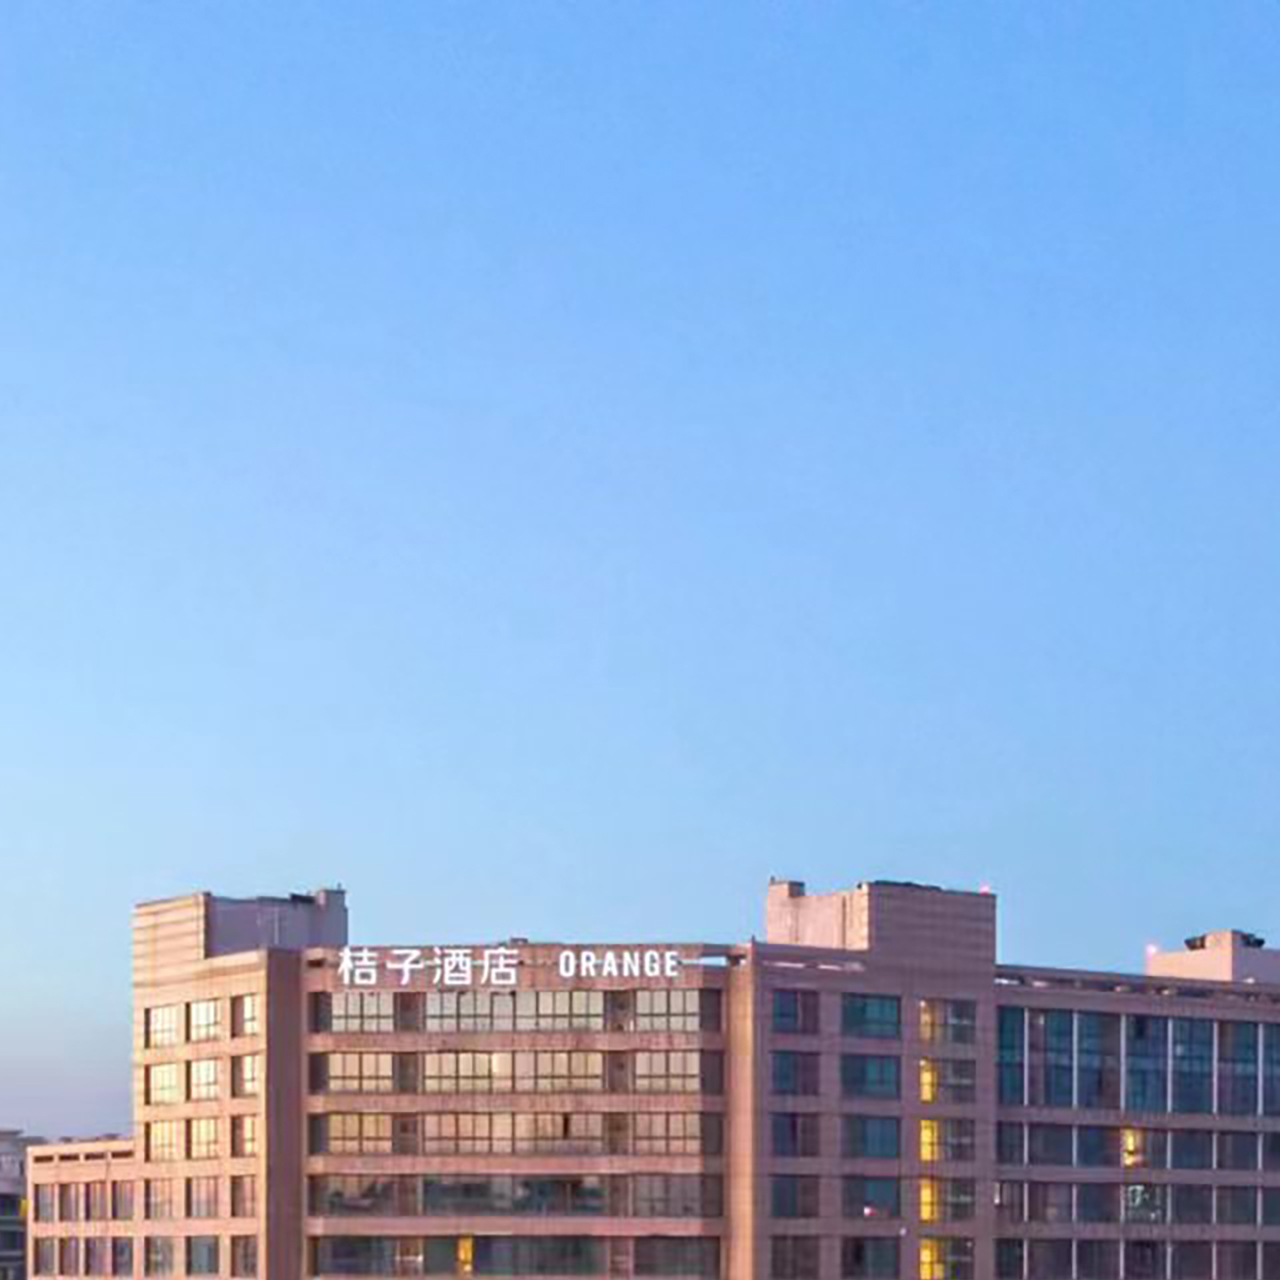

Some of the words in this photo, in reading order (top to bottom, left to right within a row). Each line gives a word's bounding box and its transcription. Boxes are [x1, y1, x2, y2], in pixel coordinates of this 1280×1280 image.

[337, 946, 519, 985] 桔子酒店
[559, 950, 678, 978] ORANGE
